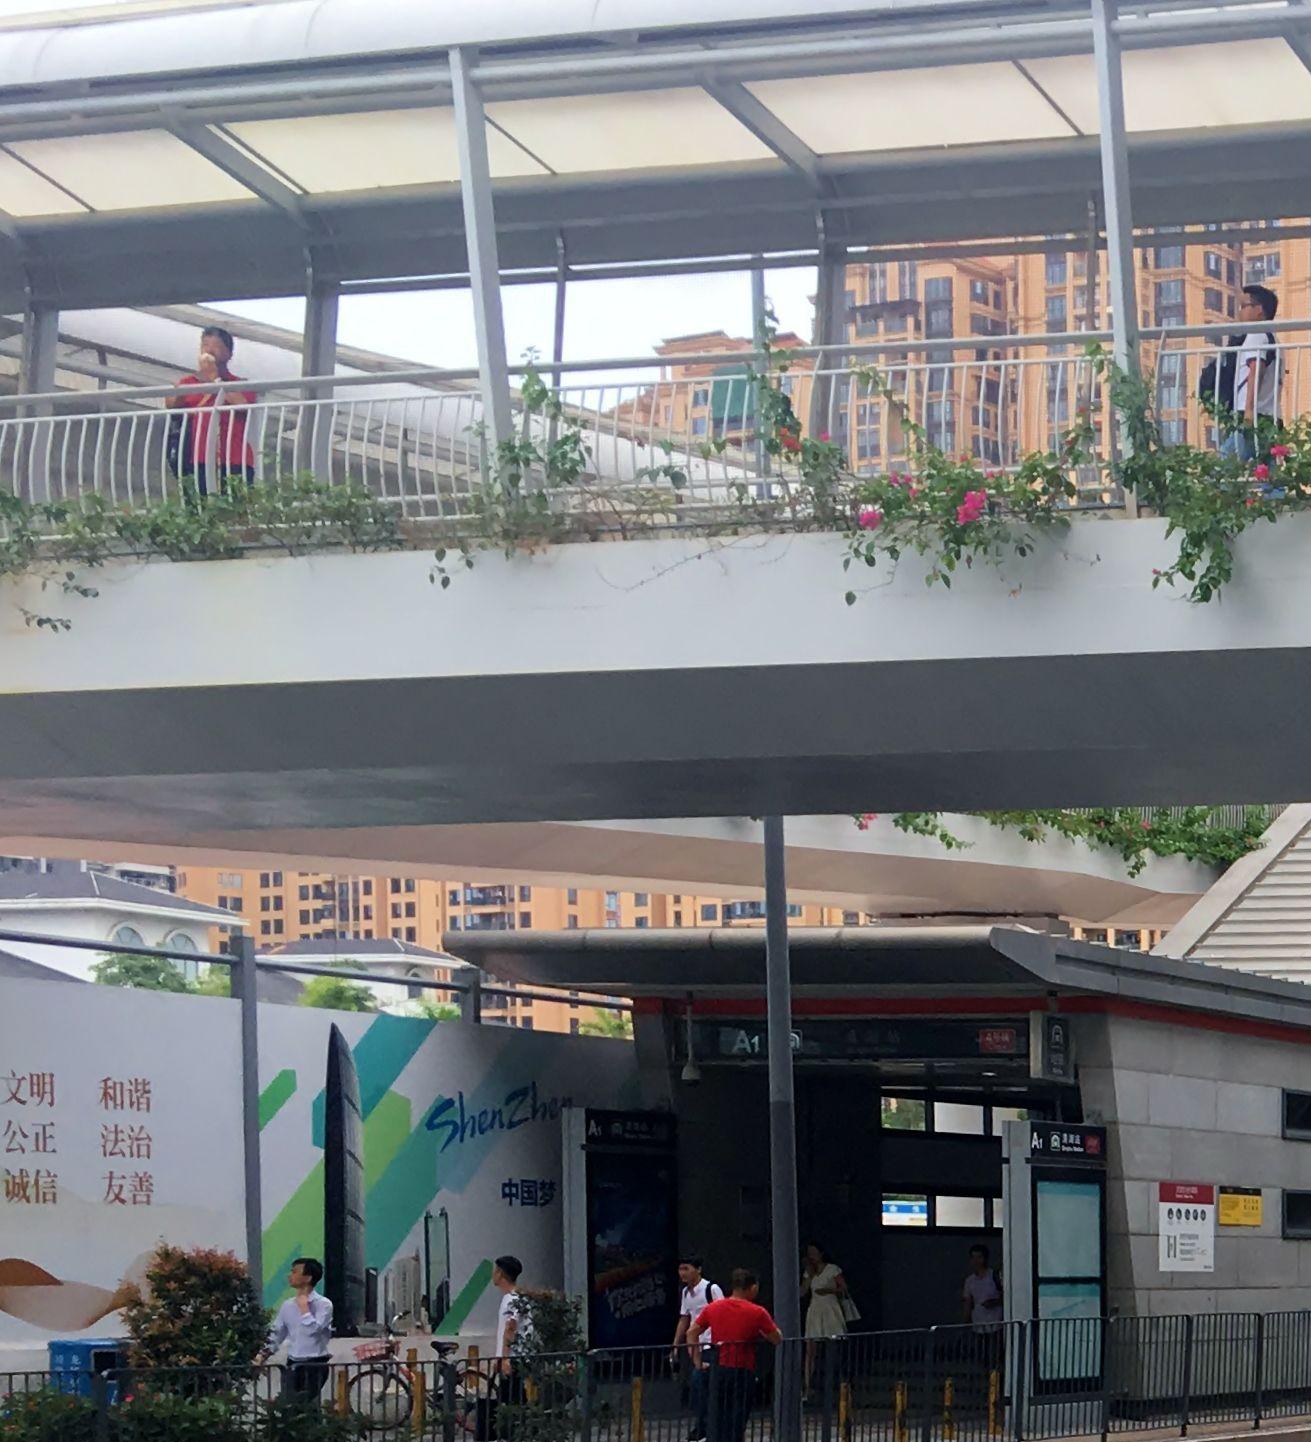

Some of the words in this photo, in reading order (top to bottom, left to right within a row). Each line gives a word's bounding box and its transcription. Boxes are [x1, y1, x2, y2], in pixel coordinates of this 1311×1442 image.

[732, 1030, 759, 1053] A1
[0, 1070, 56, 1107] 文明
[99, 1077, 152, 1112] 和谐
[3, 1119, 57, 1154] 公正
[101, 1123, 153, 1159] 法治
[4, 1168, 58, 1204] 诚信
[102, 1171, 154, 1206] 友善
[501, 1178, 556, 1206] 中国梦
